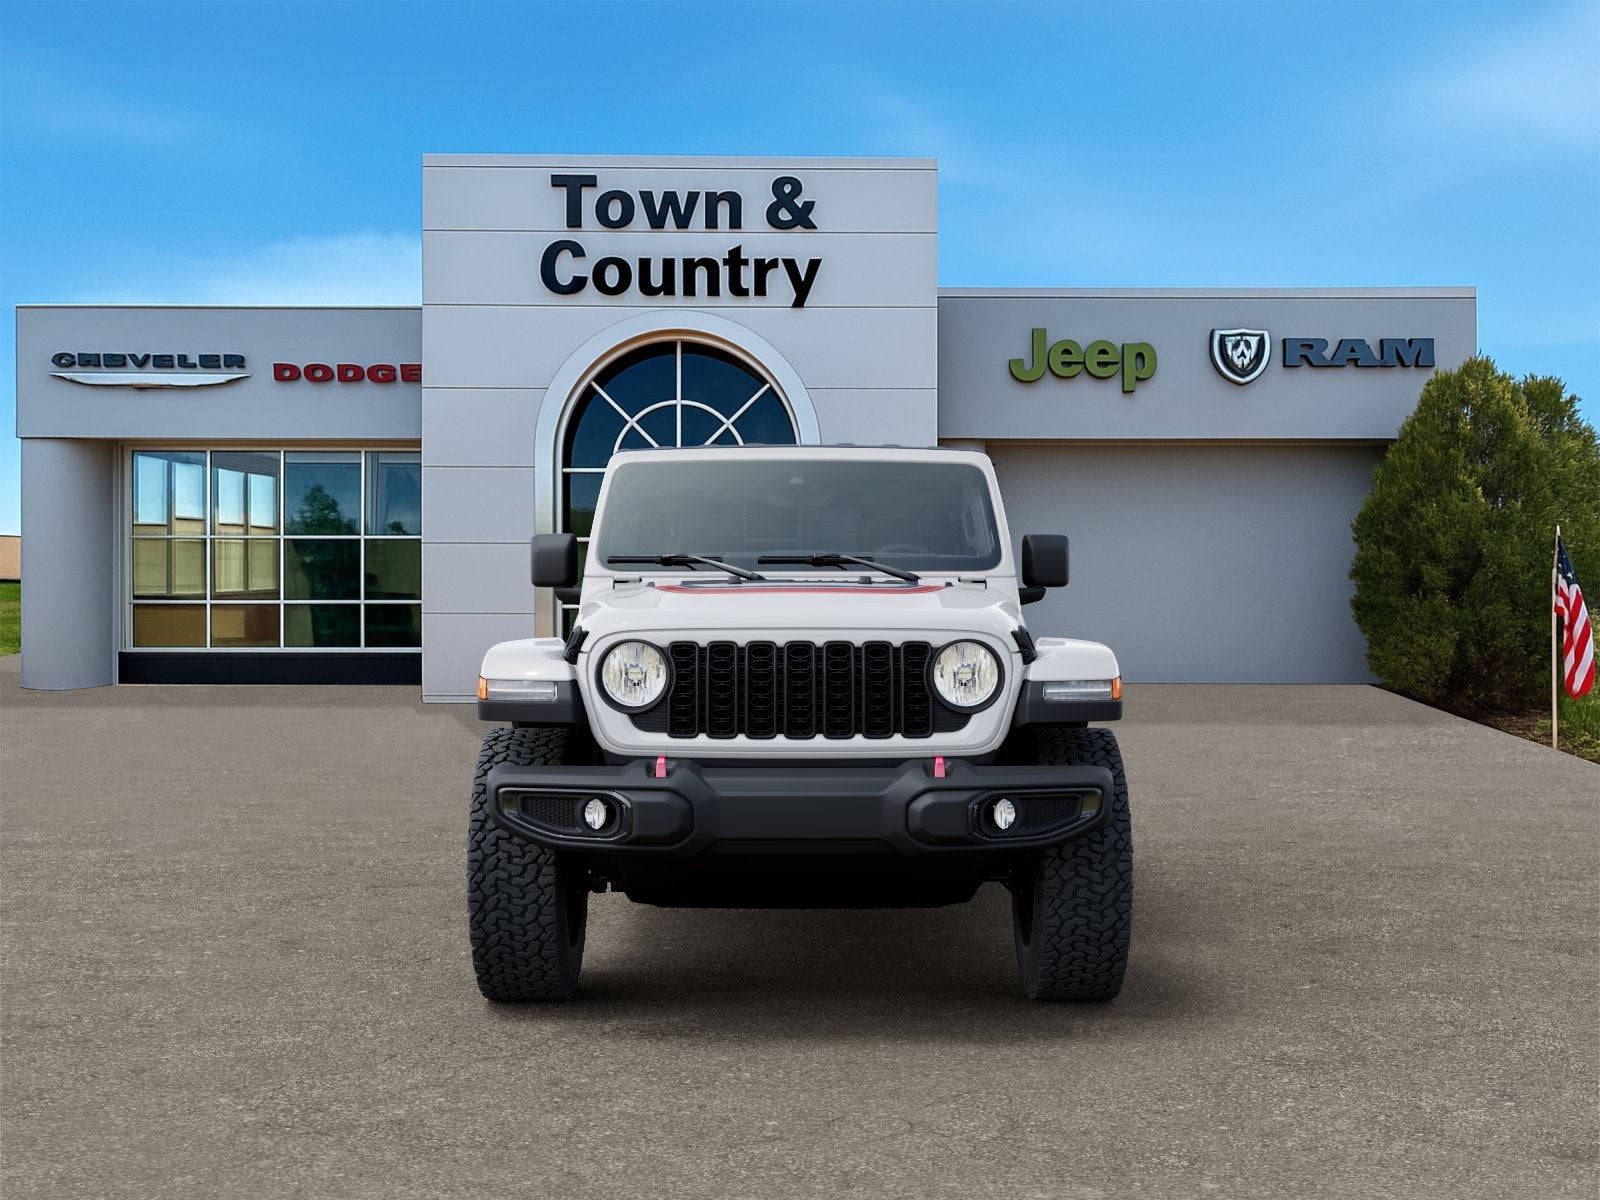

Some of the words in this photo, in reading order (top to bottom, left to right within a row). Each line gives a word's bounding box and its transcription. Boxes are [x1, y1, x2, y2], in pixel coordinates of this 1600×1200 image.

[551, 174, 742, 230] Town
[766, 176, 818, 230] &
[540, 239, 822, 309] Country
[272, 362, 422, 383] DODGE
[1009, 327, 1158, 394] Jeep
[1282, 337, 1436, 368] RAM
